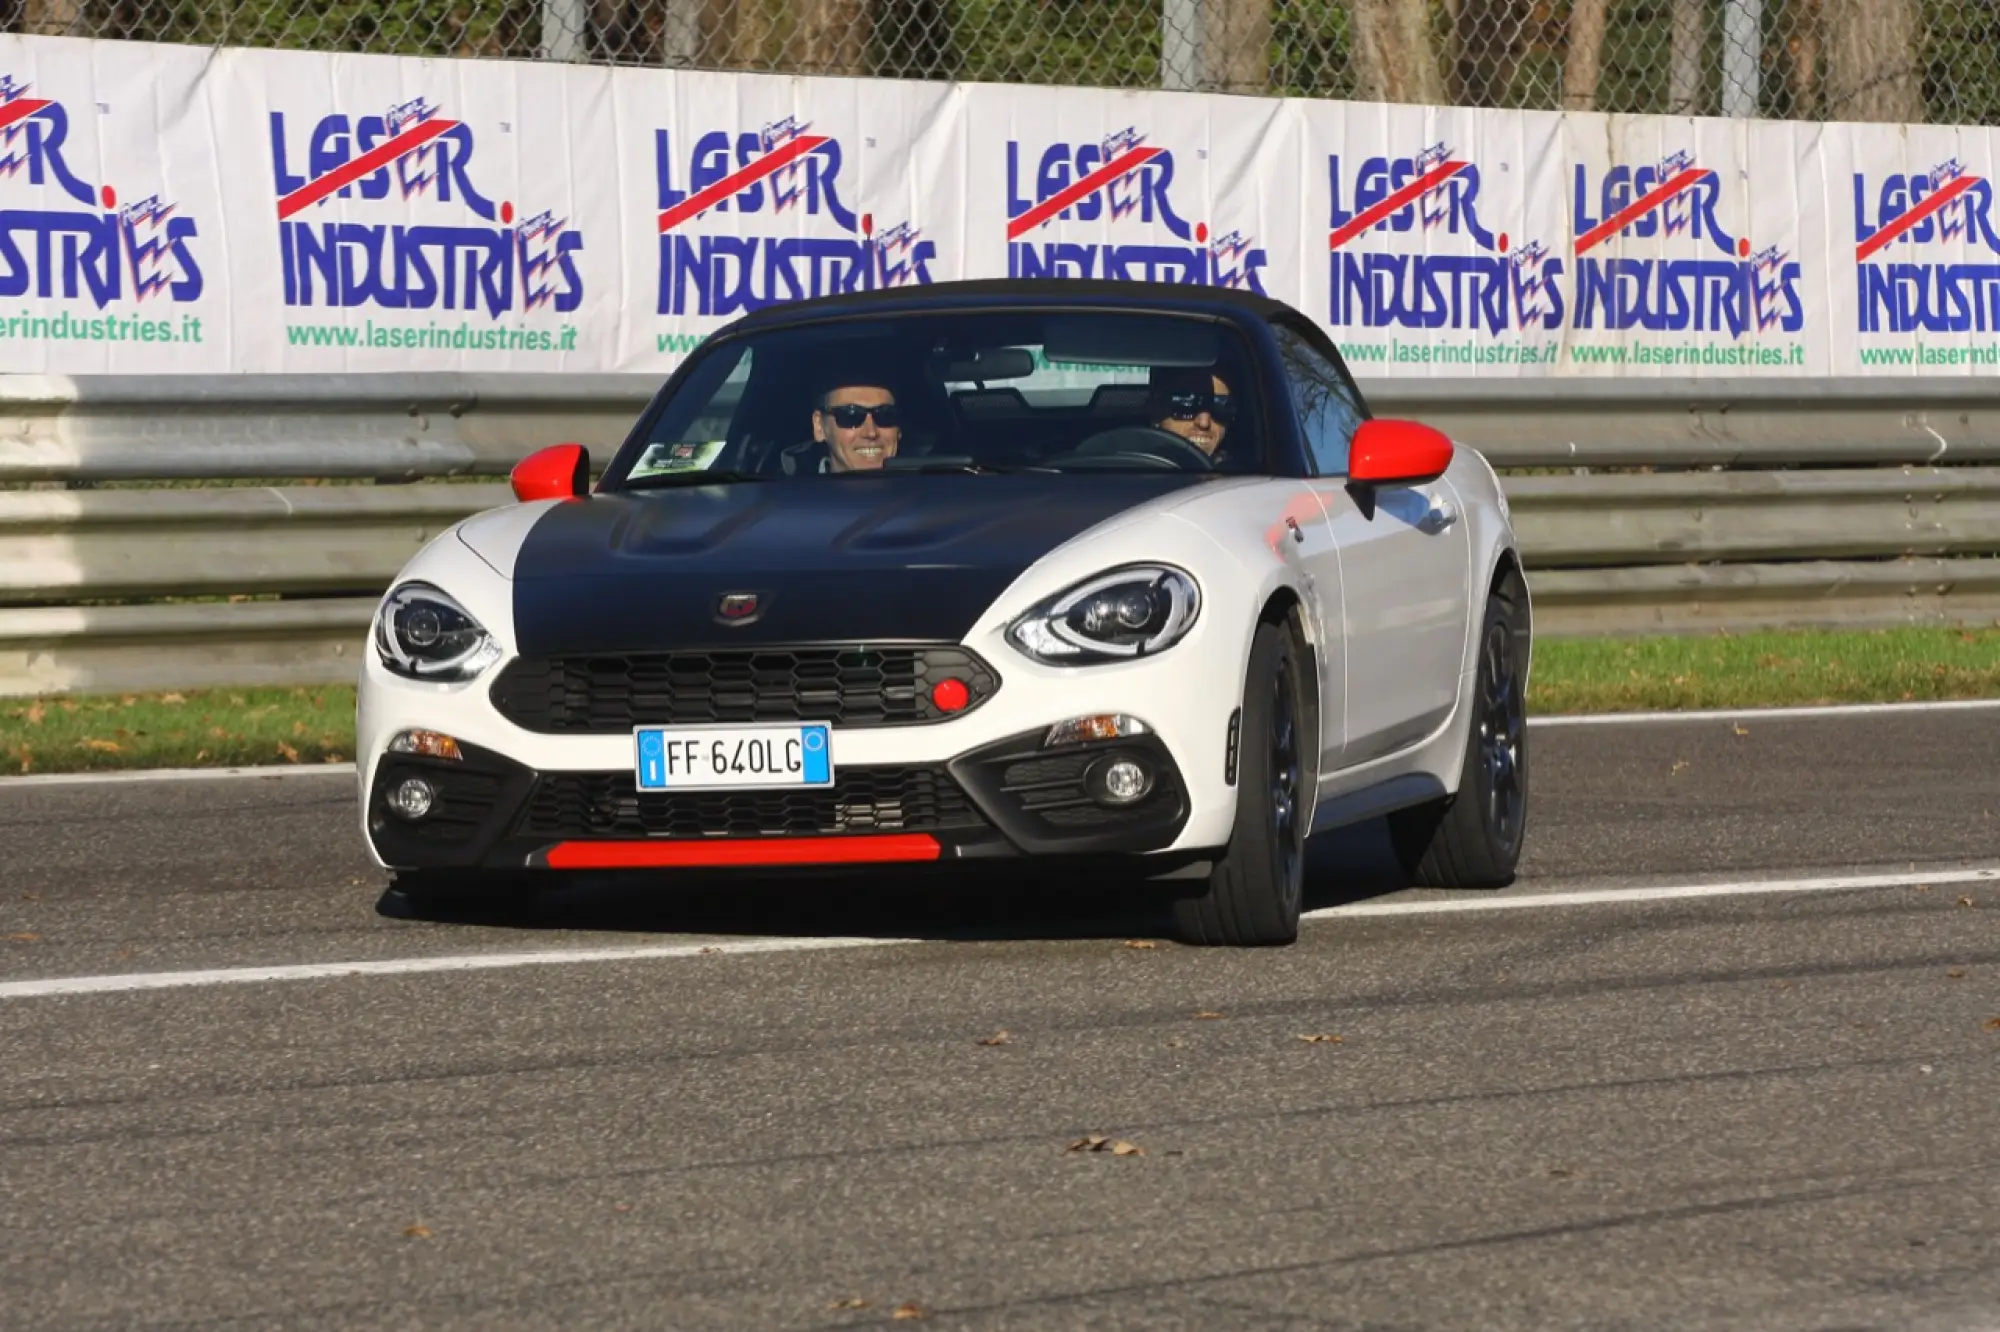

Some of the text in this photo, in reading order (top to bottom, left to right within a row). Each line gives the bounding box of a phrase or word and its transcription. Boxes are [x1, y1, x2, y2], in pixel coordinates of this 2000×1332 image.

[270, 97, 495, 221] LASER
[656, 113, 857, 233] LASER
[1007, 126, 1191, 243] LASER
[1329, 142, 1494, 250] LASER
[1574, 149, 1735, 257] LASER
[287, 320, 578, 351] www.laserindustries.it
[1338, 337, 1559, 364] www.laserindustries.it
[1571, 340, 1805, 365] www.laserindustries.it
[1860, 342, 2000, 365] www.laserind
[667, 738, 802, 775] FF 640LG
